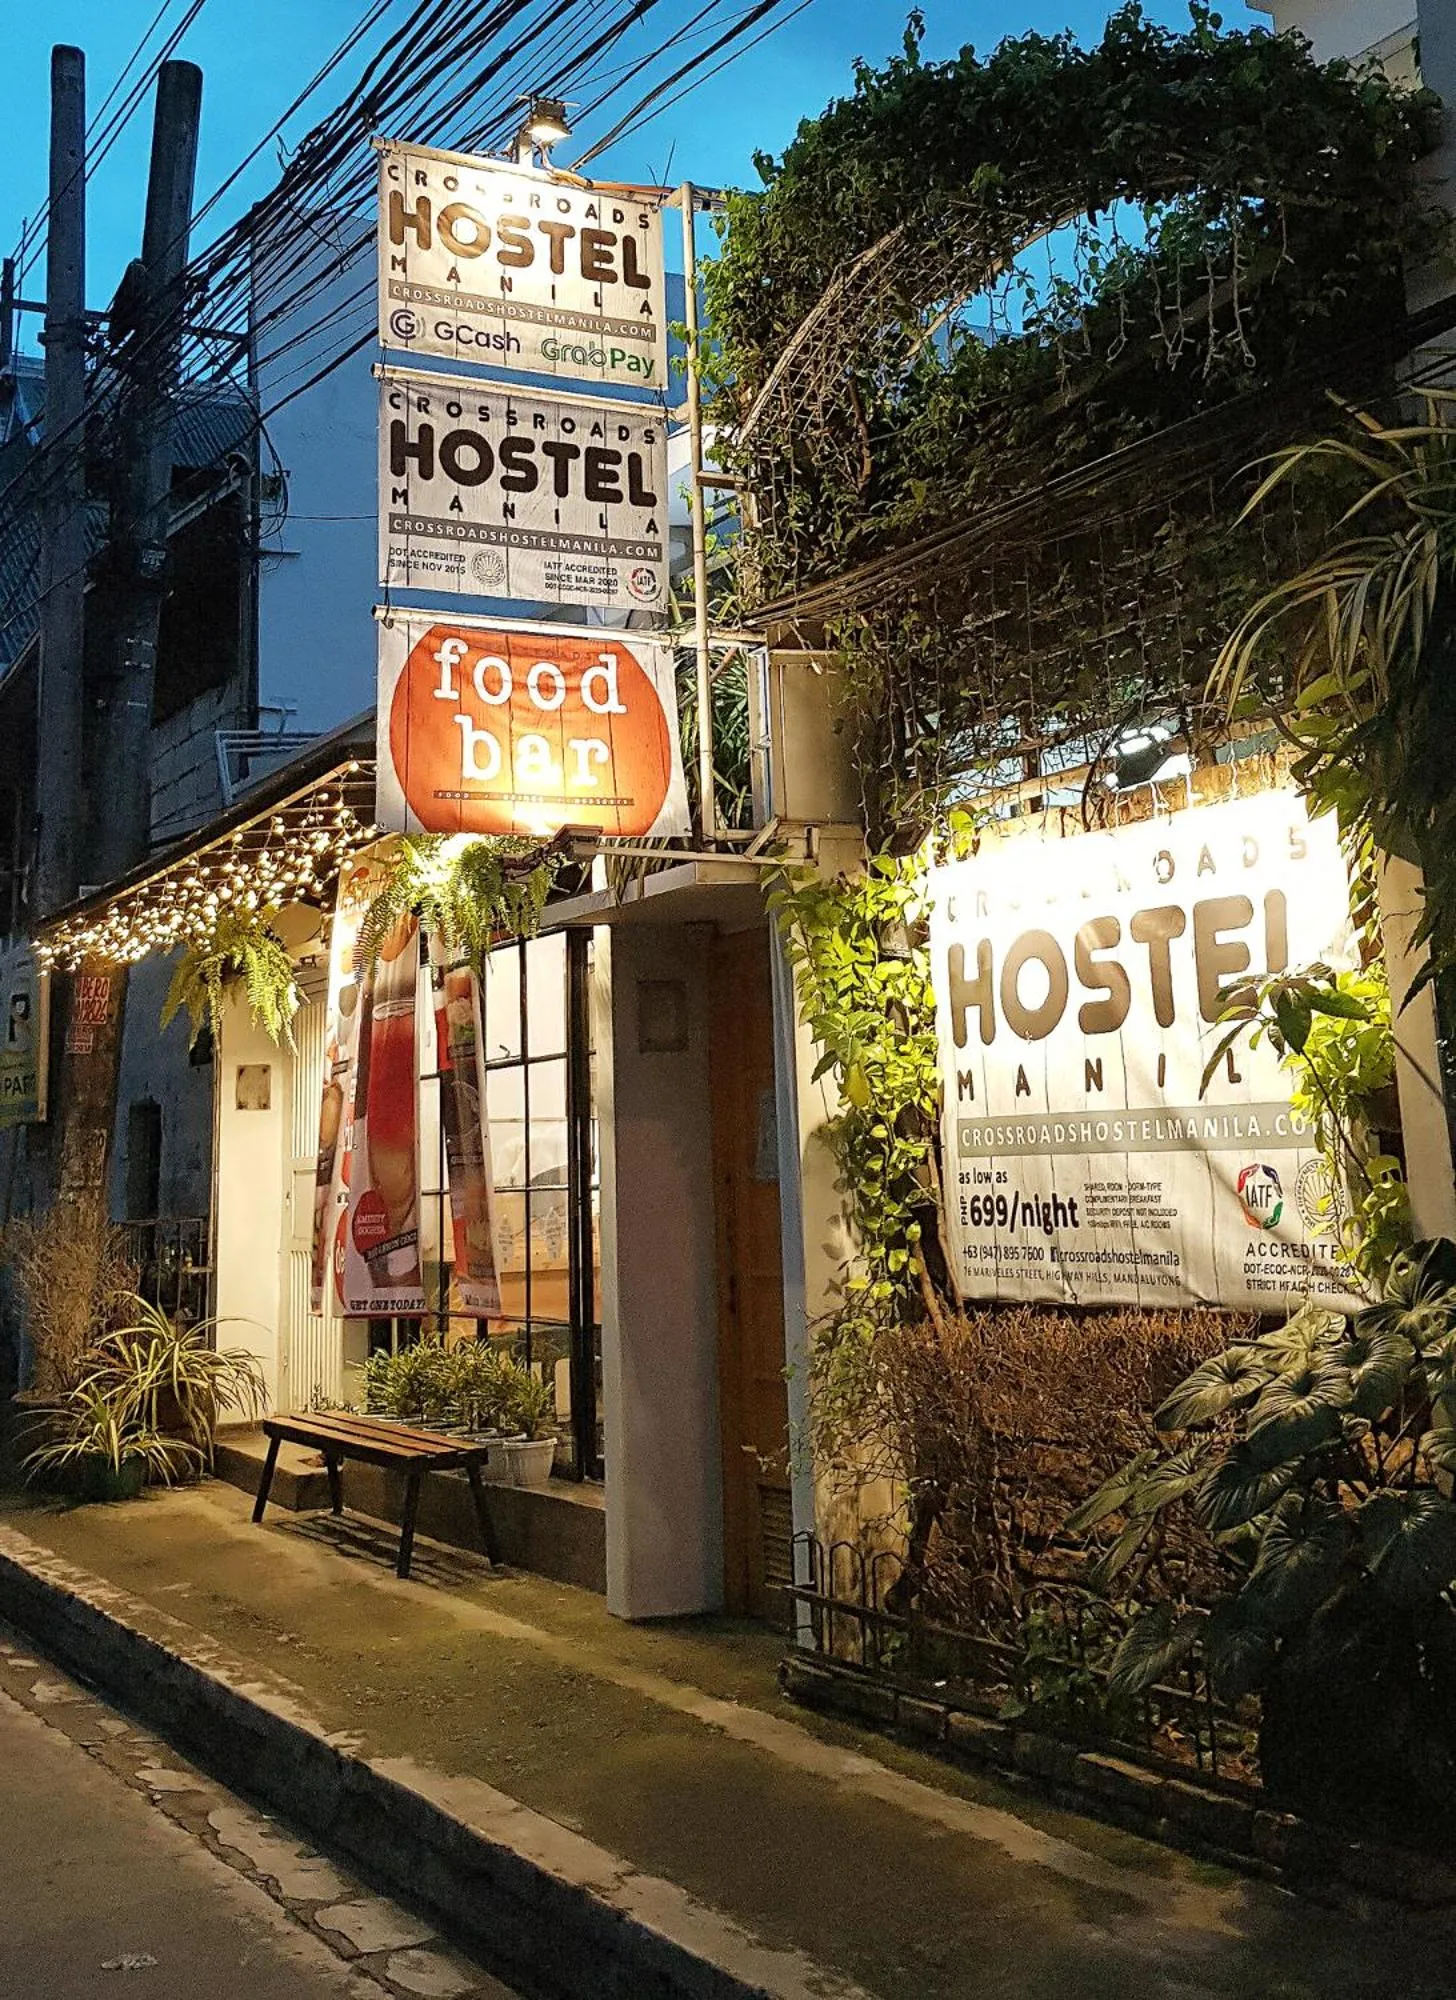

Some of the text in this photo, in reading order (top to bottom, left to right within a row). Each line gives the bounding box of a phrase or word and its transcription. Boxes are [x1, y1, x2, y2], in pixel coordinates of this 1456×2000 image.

[389, 190, 651, 290] HOSTEL
[391, 255, 653, 316] MANILA
[393, 286, 653, 337] CROSSROADSHOSTELMANILA.COM
[434, 321, 521, 354] GCash
[540, 338, 655, 379] GrabPay
[389, 393, 656, 444] CROSSROADS
[390, 419, 657, 508] HOSTEL
[392, 488, 659, 534] MANILA
[393, 518, 659, 558] CROSSROADSHOSTELMANILA.COM
[410, 549, 466, 563] ACCREDITED
[389, 559, 419, 570] SINCE
[422, 561, 443, 571] NOV
[545, 572, 573, 583] SINCE
[575, 575, 596, 585] MAR
[565, 563, 618, 576] ACCREDITED
[433, 638, 627, 716] food
[454, 715, 609, 787] bar
[962, 1112, 1334, 1148] CROSSROADSHOSTELMANILA.CO
[959, 1167, 1008, 1184] as low as
[960, 1195, 968, 1226] PHP
[970, 1190, 1079, 1235] 699/night
[1246, 1185, 1272, 1208] IATF
[963, 1245, 977, 1259] +63
[980, 1245, 1002, 1262] (947)
[1004, 1246, 1019, 1260] 895
[1060, 1248, 1180, 1266] crossroadshostelmanila
[1246, 1242, 1341, 1260] ACCREDITE
[1246, 1280, 1277, 1291] STRICT
